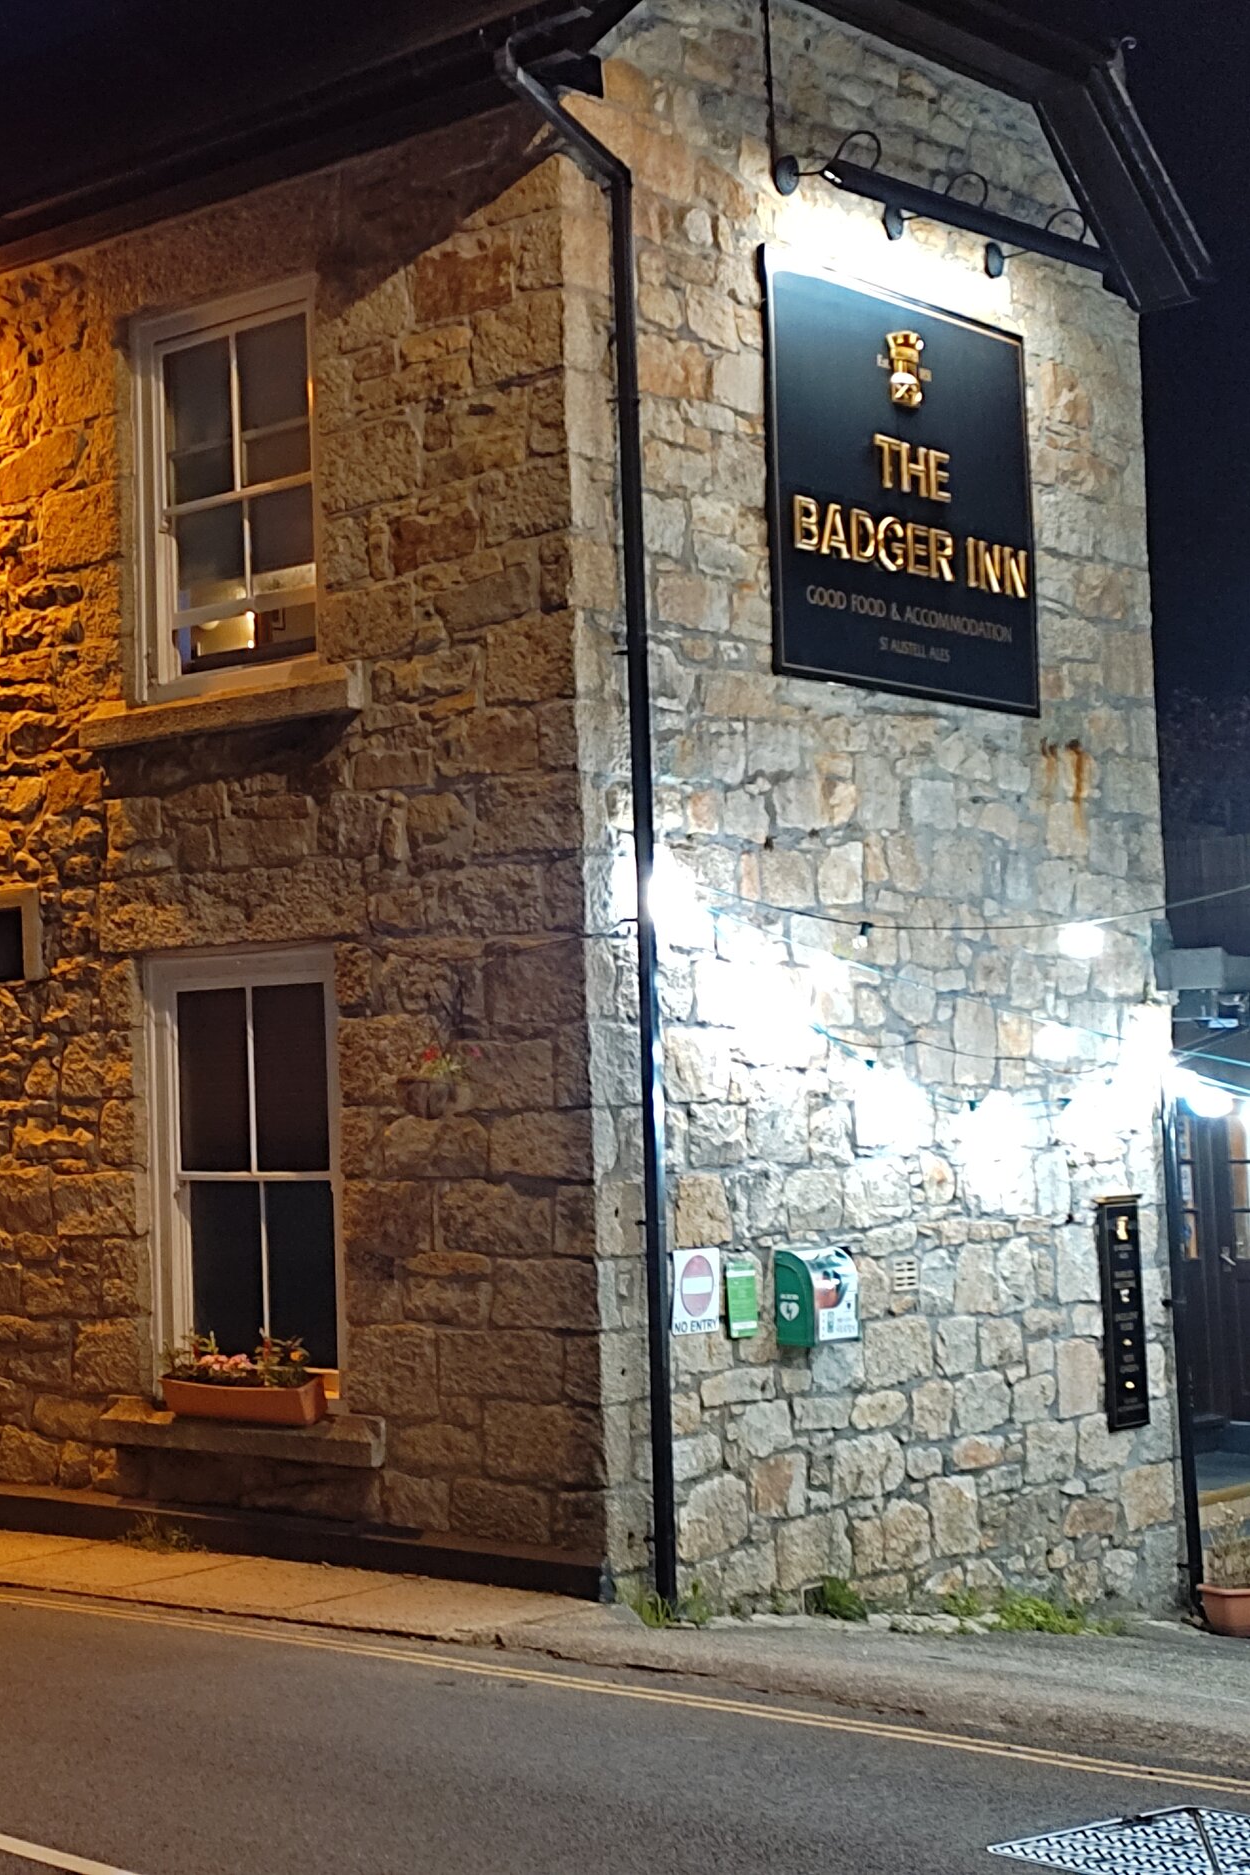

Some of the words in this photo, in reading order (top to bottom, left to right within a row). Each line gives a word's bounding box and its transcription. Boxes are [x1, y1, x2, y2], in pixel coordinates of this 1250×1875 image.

[873, 432, 951, 502] THE
[793, 494, 955, 582] BADGER
[966, 537, 1029, 599] INN
[806, 584, 847, 610] GOOD
[851, 594, 887, 618] FOOD
[890, 602, 901, 622] &
[904, 606, 1013, 643] ACCOMMODATION
[890, 640, 926, 658] AUSTELL
[929, 646, 951, 663] ALES
[675, 1321, 688, 1333] NO
[690, 1318, 718, 1332] ENTRY
